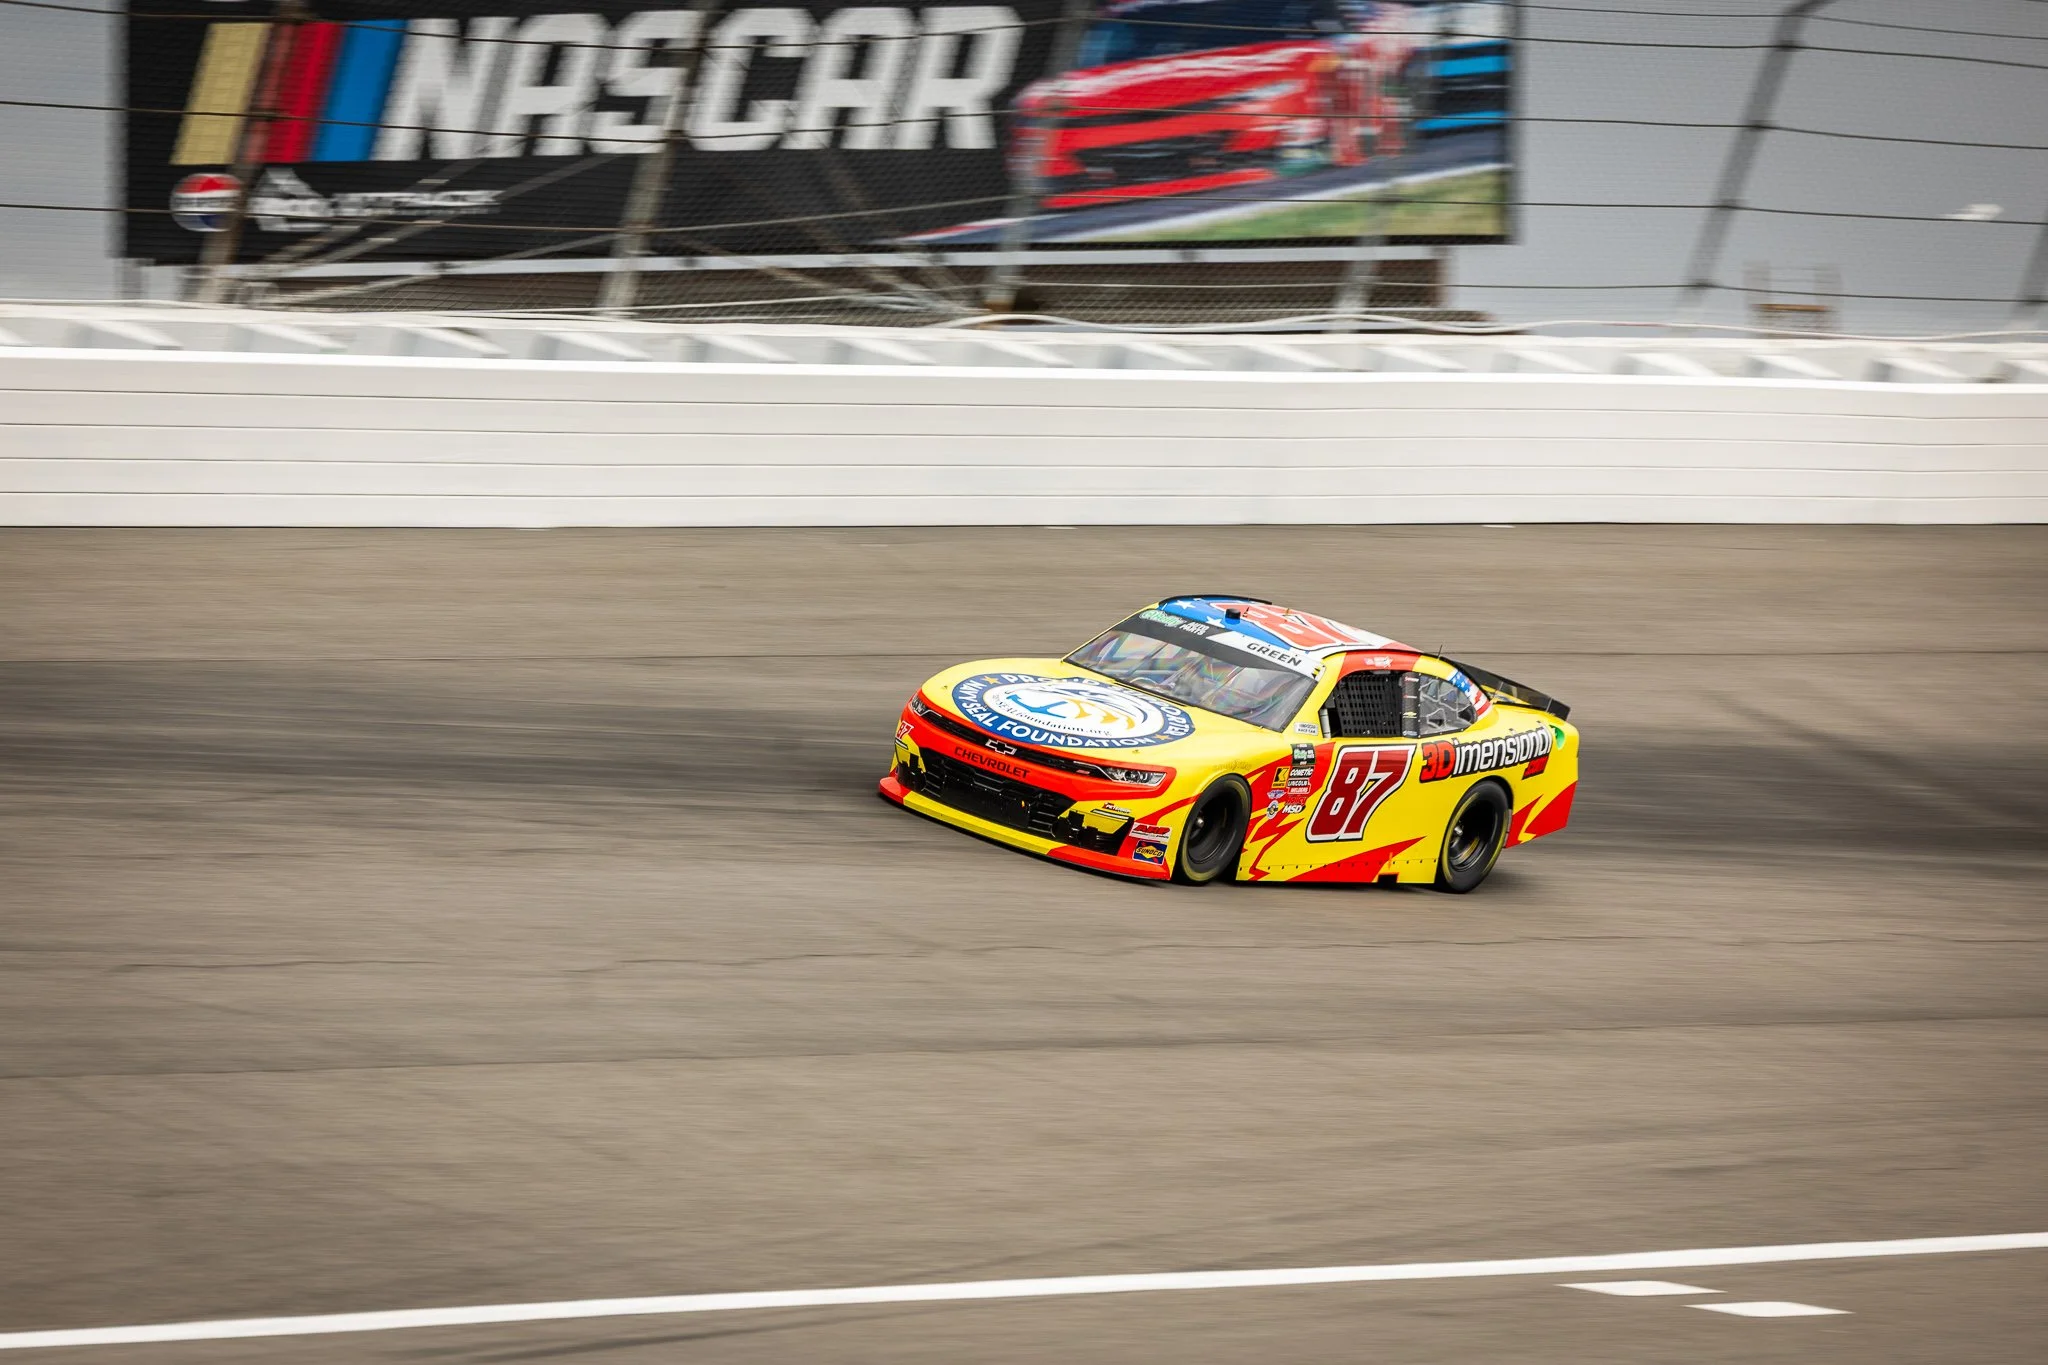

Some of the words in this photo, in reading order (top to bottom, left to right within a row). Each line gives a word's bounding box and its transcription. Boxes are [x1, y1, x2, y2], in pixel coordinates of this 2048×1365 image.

[370, 6, 1024, 162] NASCAR
[1247, 643, 1302, 667] GREEN
[959, 679, 987, 702] NAVY
[962, 702, 999, 727] SEAL
[997, 720, 1156, 748] FOUNDATION
[954, 747, 1031, 779] CHEVROLET
[1420, 722, 1552, 783] 3Dimensional
[1305, 743, 1417, 843] 87
[1282, 804, 1304, 814] MSD
[1133, 824, 1170, 835] ARP
[1137, 847, 1164, 858] SUNOCO
